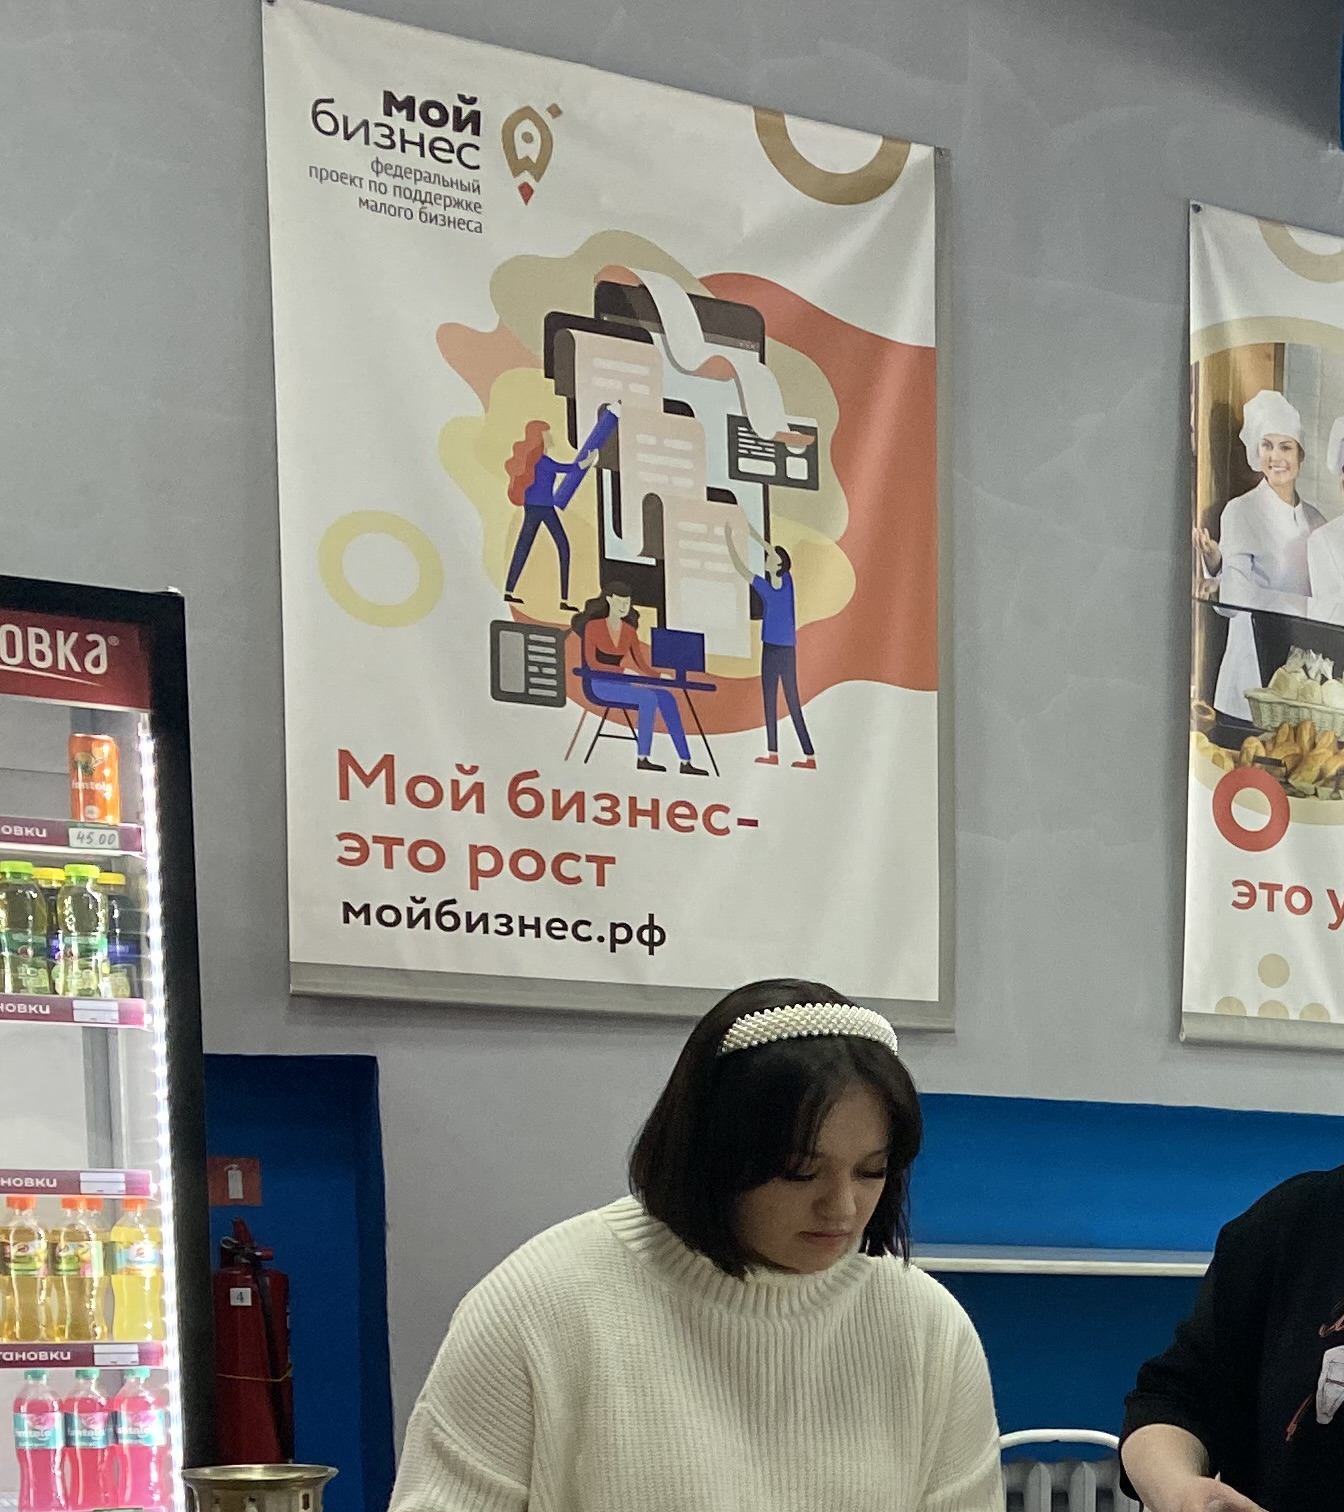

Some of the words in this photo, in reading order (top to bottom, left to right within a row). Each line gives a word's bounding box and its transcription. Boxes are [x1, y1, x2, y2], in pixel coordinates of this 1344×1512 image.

[311, 97, 481, 170] бизнес
[383, 89, 481, 137] мой
[309, 165, 364, 189] проект
[368, 179, 388, 195] по
[393, 184, 482, 214] поддержке
[370, 156, 481, 195] федеральный
[358, 196, 414, 220] малого
[418, 205, 483, 234] бизнеса
[338, 748, 486, 815] Мой
[507, 769, 759, 837] бизнес-
[336, 831, 447, 873] это
[468, 843, 617, 891] рост
[1231, 879, 1313, 916] это
[341, 896, 667, 956] мойбизнес.рф
[236, 1291, 245, 1303] 4
